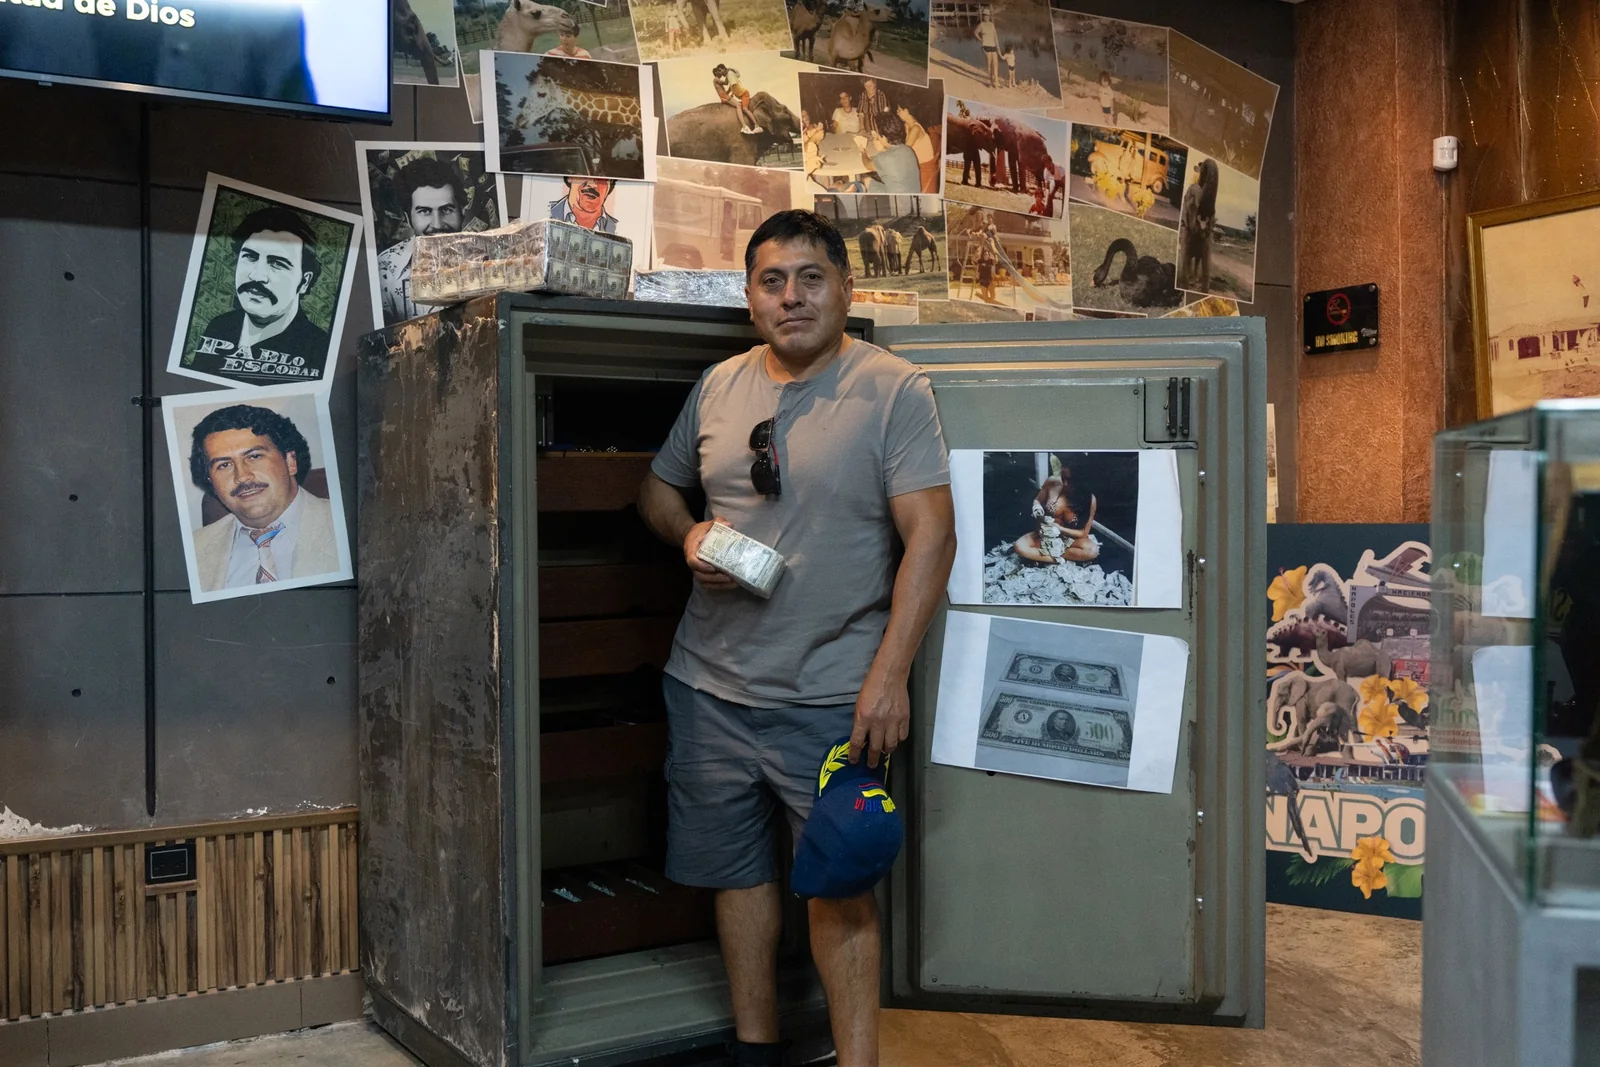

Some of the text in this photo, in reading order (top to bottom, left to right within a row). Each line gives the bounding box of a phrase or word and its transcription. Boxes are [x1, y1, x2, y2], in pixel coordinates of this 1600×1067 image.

[126, 0, 195, 27] Dios
[195, 335, 305, 366] PABLO
[220, 357, 320, 377] ESCOBAR
[983, 731, 999, 739] 500
[1085, 721, 1115, 741] 500
